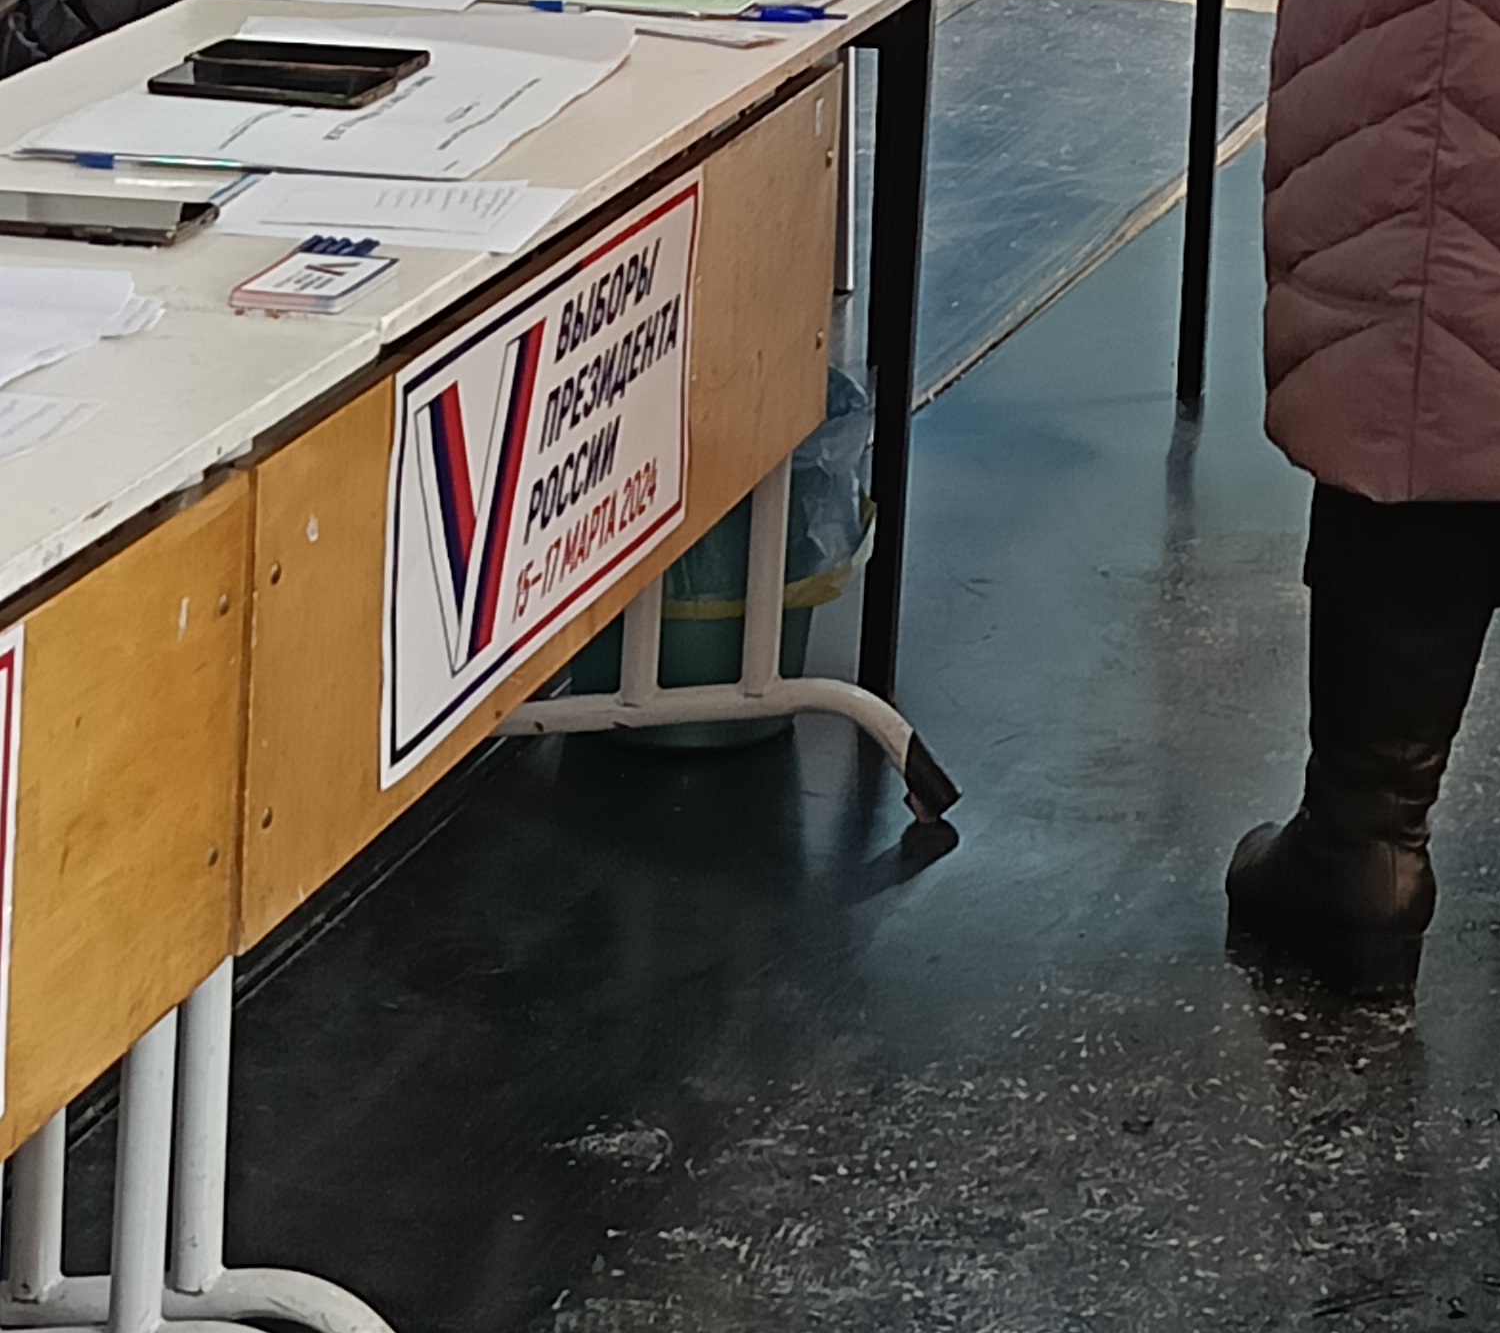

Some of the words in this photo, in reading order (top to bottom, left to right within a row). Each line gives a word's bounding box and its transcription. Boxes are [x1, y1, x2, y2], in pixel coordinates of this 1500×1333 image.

[554, 236, 662, 364] ВЫБОРЫ
[538, 293, 681, 455] ПРЕЗИДЕНТА
[522, 414, 622, 546] РОССИИ
[559, 489, 618, 583] МАРТА
[619, 456, 658, 532] 2024
